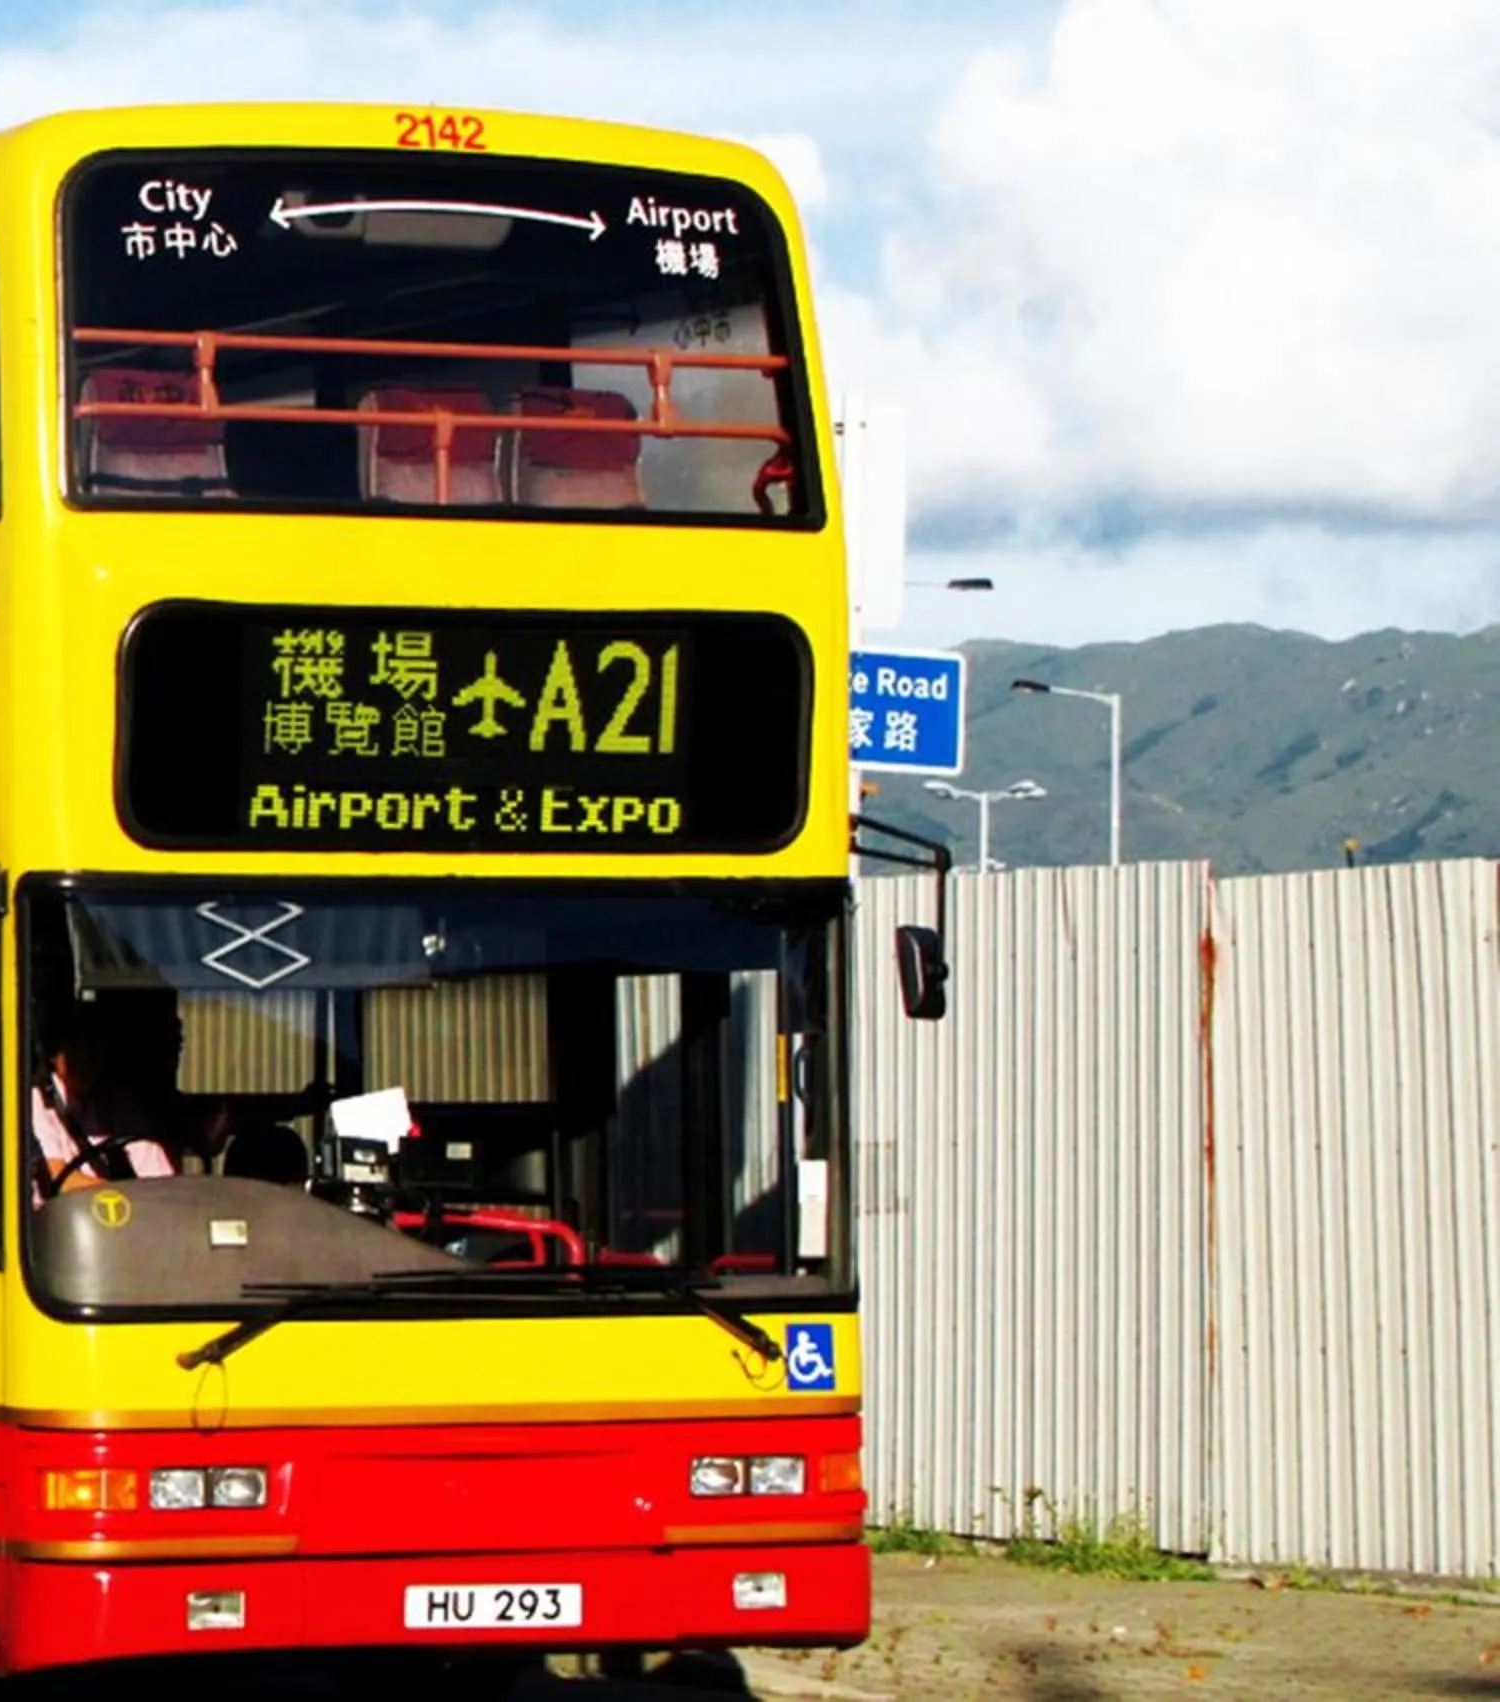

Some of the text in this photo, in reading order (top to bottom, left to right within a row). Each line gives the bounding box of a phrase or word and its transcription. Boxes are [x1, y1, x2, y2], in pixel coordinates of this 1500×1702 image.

[396, 114, 486, 149] 2142
[139, 181, 211, 219] City
[626, 197, 739, 236] Airport
[122, 222, 238, 260] 市中心
[655, 240, 721, 280] 機場
[272, 629, 438, 700] 機場
[848, 667, 948, 700] e Road
[527, 640, 680, 754] A21
[262, 703, 446, 757] 博覽館
[249, 784, 681, 834] Airport & Expo
[427, 1588, 562, 1622] HU 293
